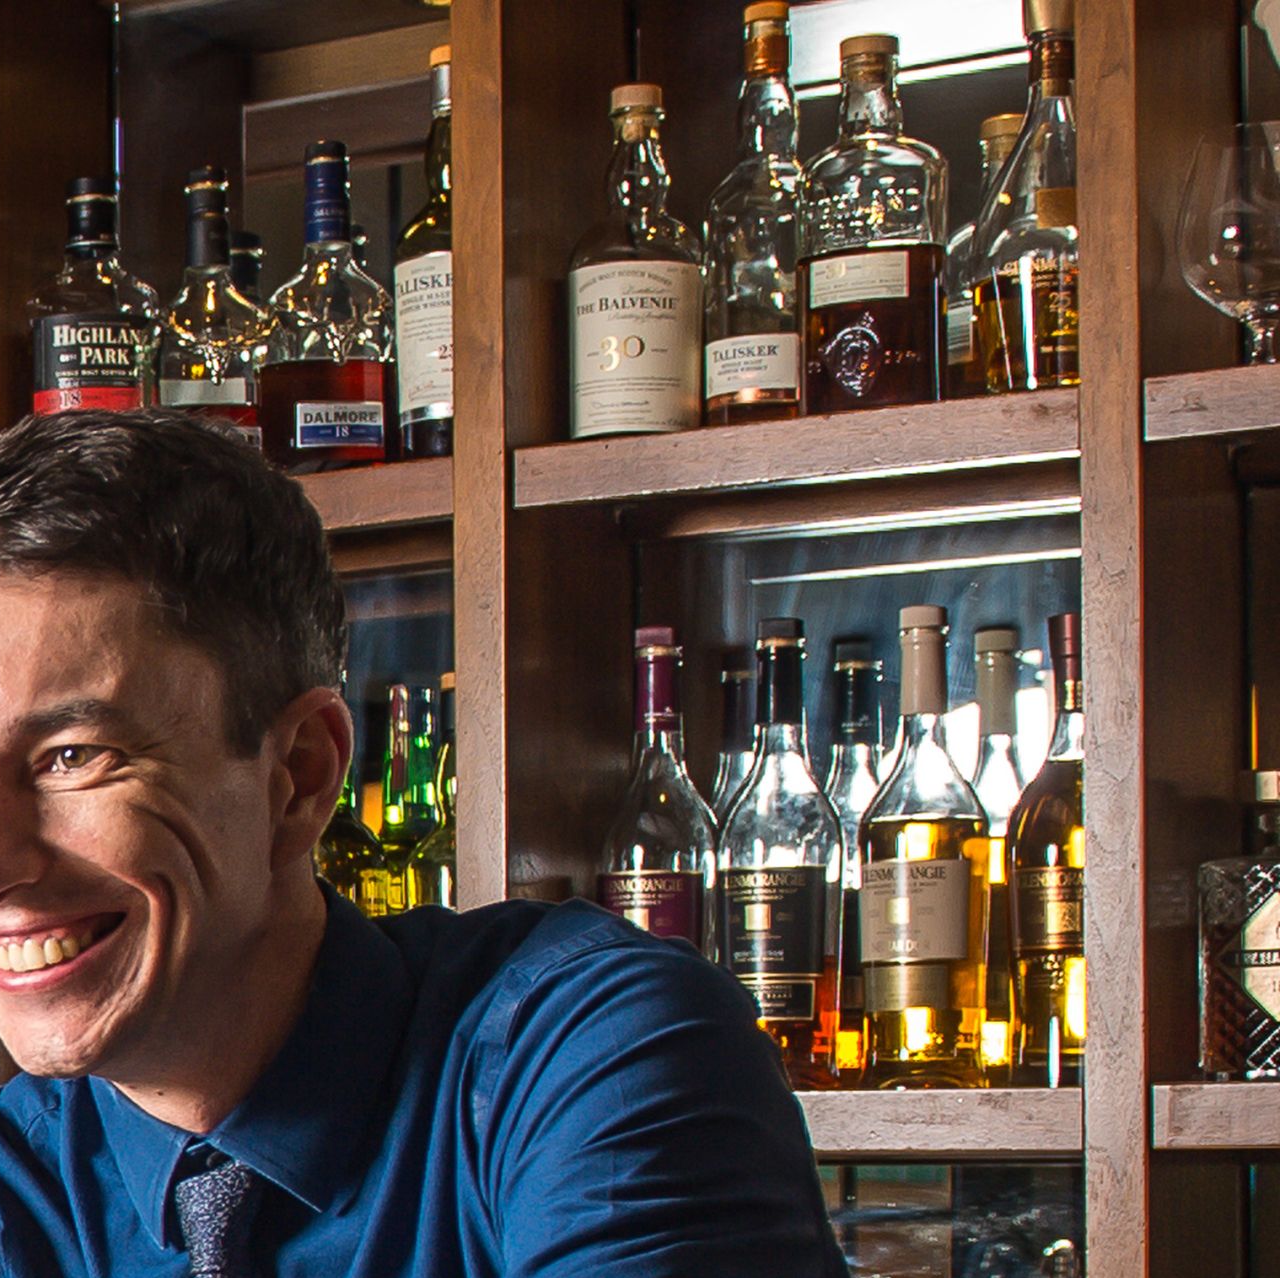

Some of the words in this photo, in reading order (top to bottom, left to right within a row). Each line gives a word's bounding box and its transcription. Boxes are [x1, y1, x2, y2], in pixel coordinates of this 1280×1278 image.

[575, 303, 595, 317] THE
[598, 297, 678, 312] BALVENIE
[1048, 291, 1072, 312] 25
[52, 324, 142, 347] HIGHLAN
[80, 346, 130, 366] PARK
[599, 334, 646, 373] 30
[712, 344, 779, 364] TALISKER
[303, 410, 378, 425] DALMORE
[335, 426, 350, 438] 18
